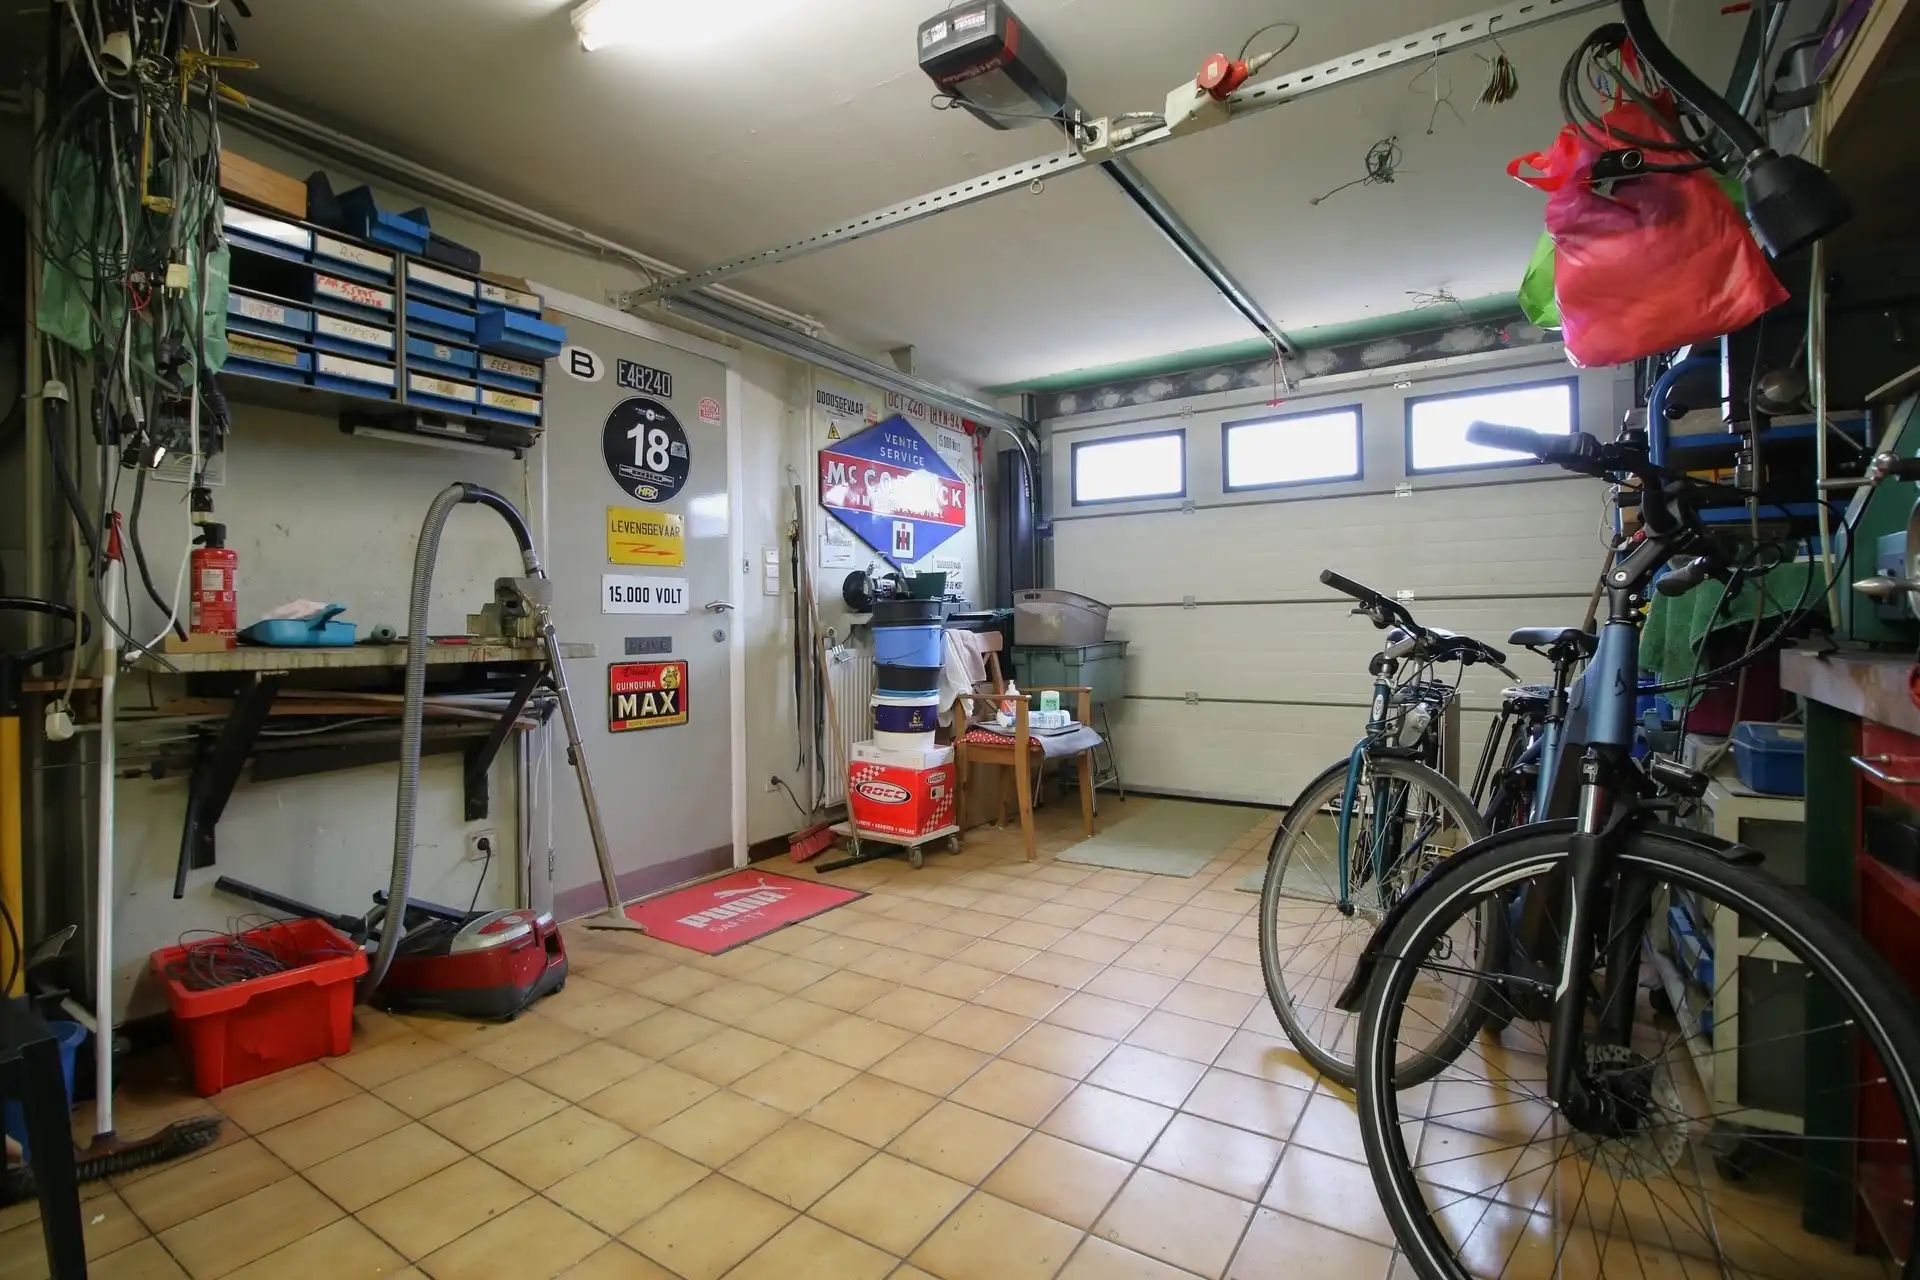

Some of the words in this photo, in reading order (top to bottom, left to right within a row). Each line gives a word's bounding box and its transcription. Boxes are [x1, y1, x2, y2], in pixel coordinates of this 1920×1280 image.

[571, 349, 596, 379] B
[627, 422, 670, 472] 18
[884, 432, 919, 451] VENTE
[880, 446, 925, 466] SERVICE
[611, 519, 681, 539] LEVENSGEVAAR
[608, 585, 650, 604] 15.000
[656, 587, 682, 604] VOLT
[616, 680, 656, 692] QUINQUINA
[617, 690, 676, 719] MAX
[709, 910, 766, 934] SAFETY
